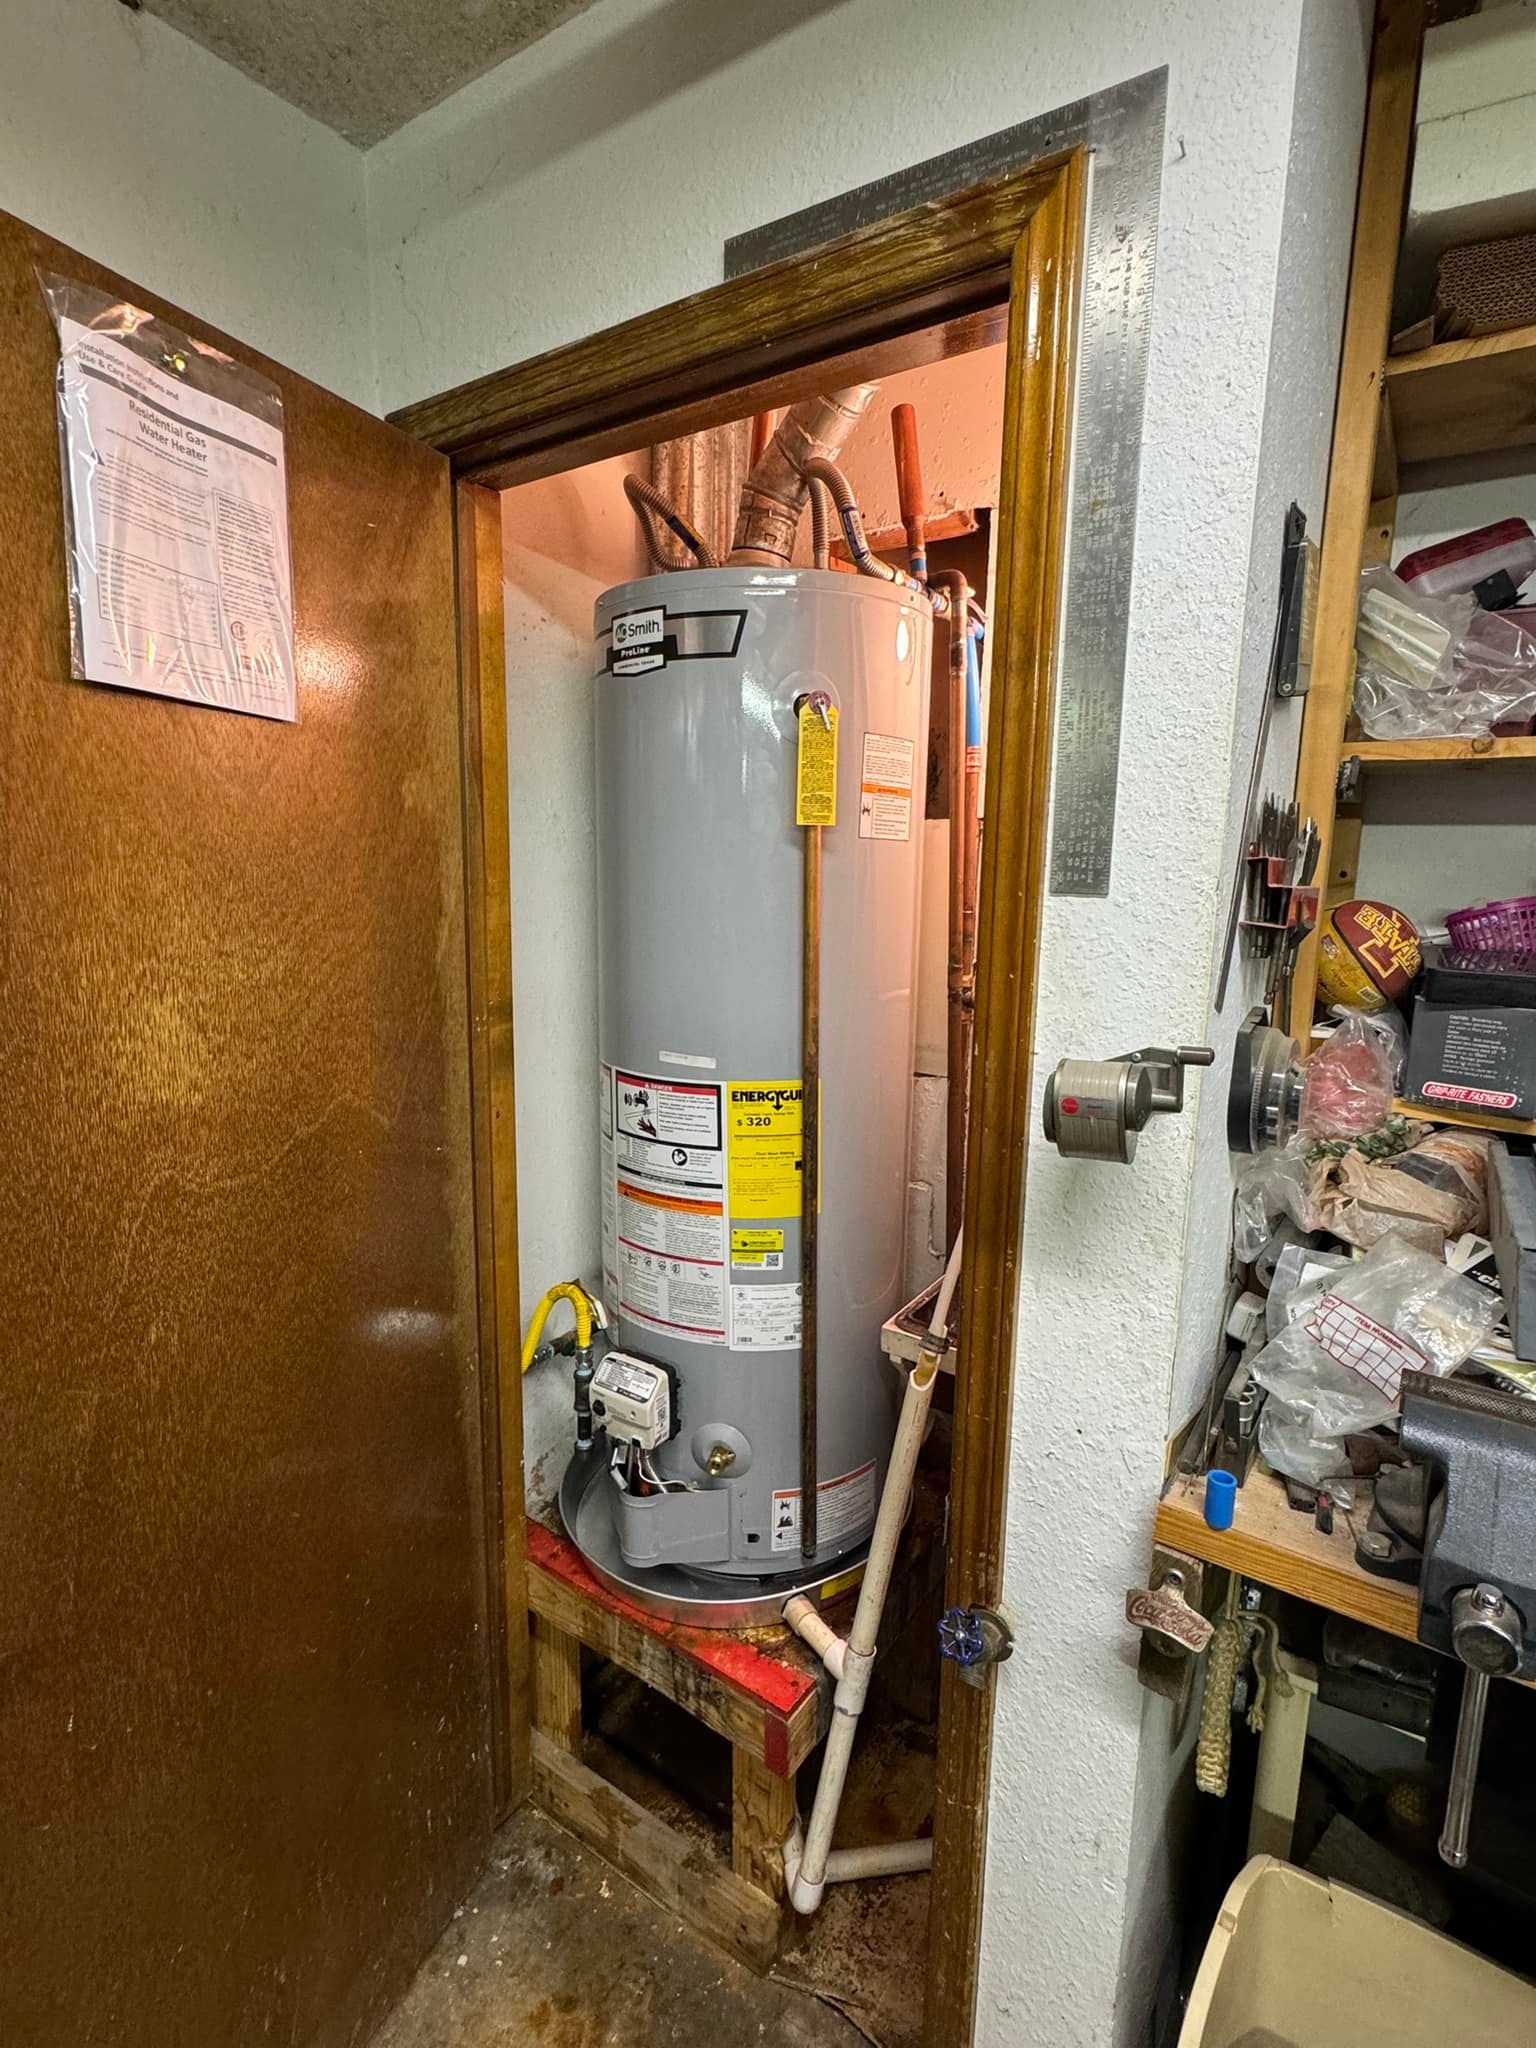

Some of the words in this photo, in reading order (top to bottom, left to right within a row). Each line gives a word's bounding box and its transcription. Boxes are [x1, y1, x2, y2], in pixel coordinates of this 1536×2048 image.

[129, 399, 184, 439] Residential
[185, 431, 207, 449] Gas
[138, 420, 170, 448] Water
[171, 441, 208, 464] Heater
[628, 619, 661, 638] Smith
[620, 646, 650, 659] ProLine
[731, 1088, 802, 1105] ENERGYGUI
[1427, 1084, 1467, 1099] GRIP-RITE
[745, 1116, 772, 1128] 320
[1354, 1316, 1371, 1330] ITEM
[1371, 1326, 1403, 1351] NUMBER
